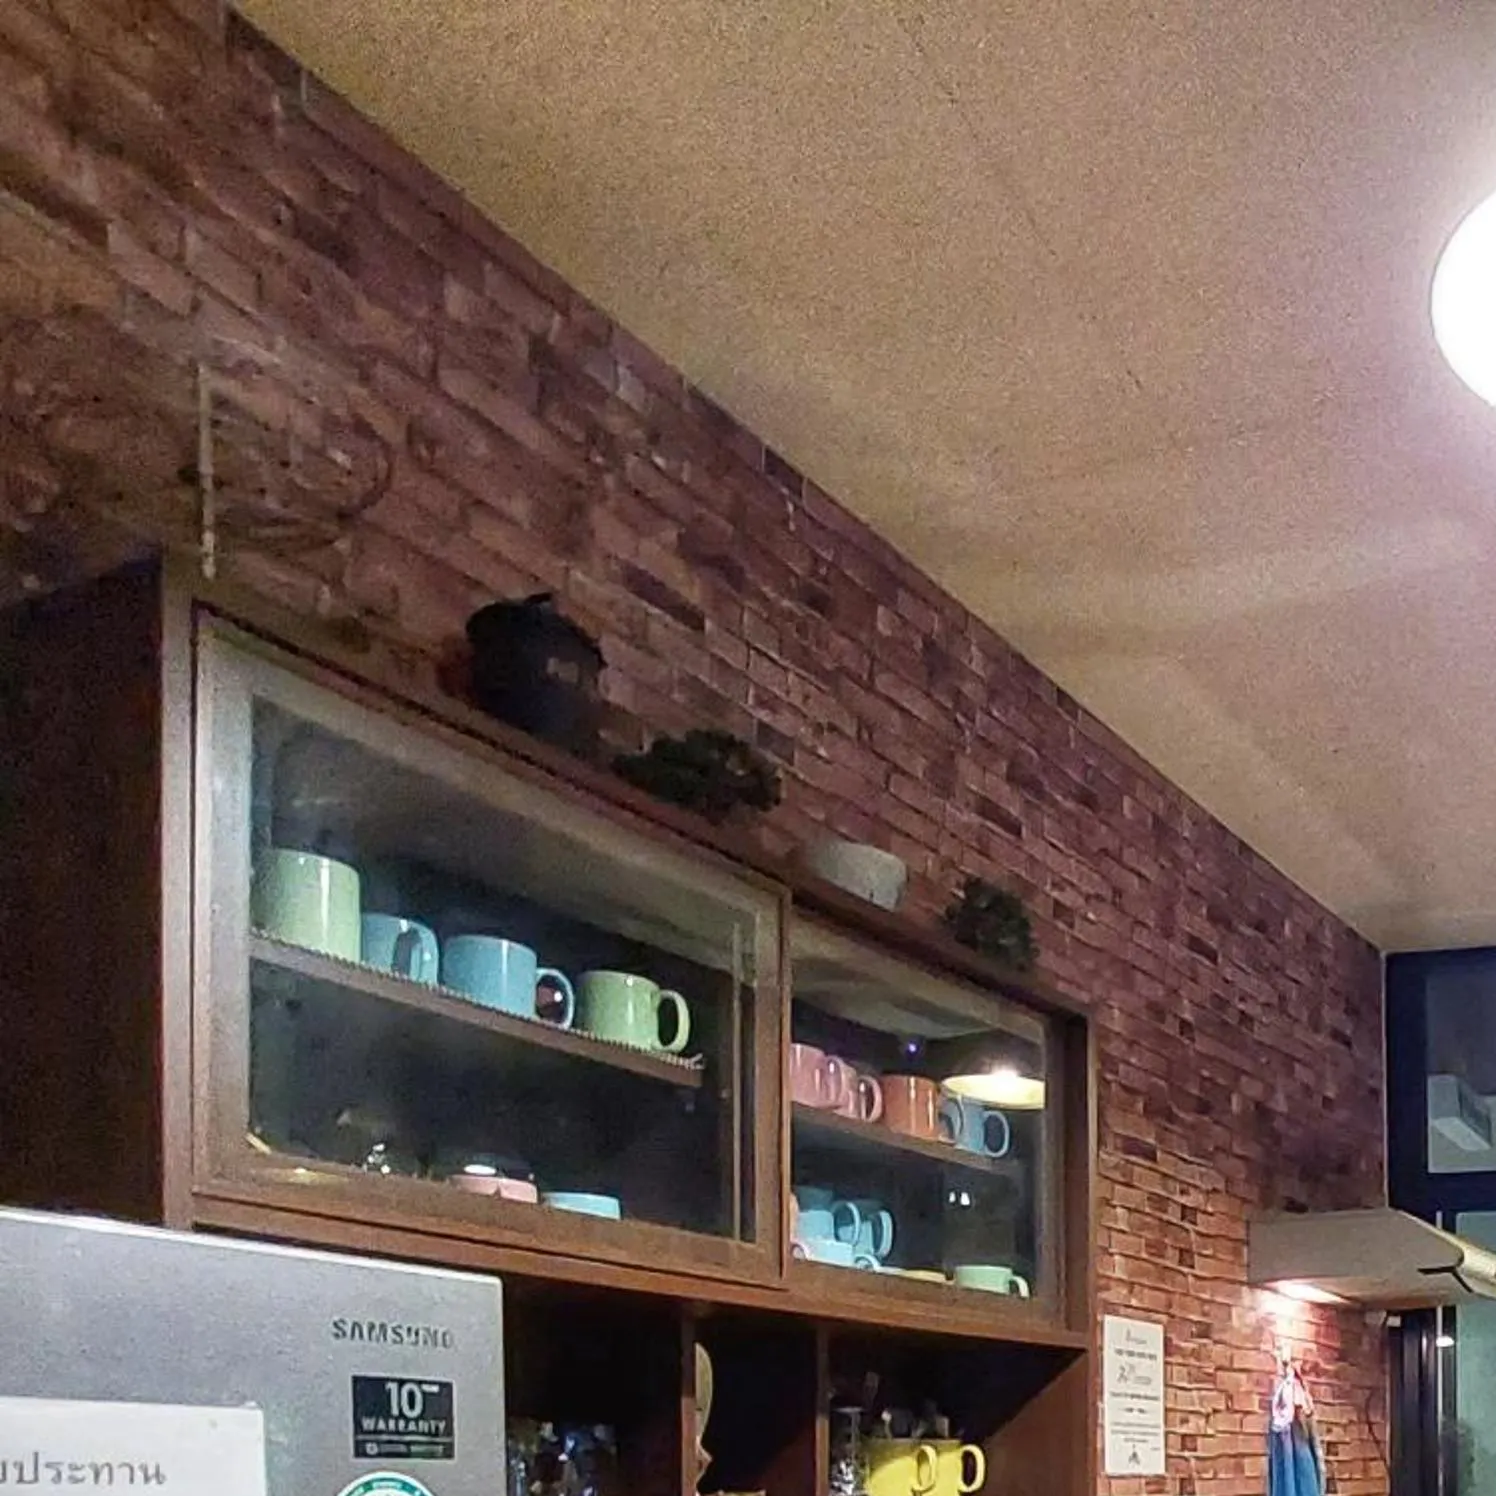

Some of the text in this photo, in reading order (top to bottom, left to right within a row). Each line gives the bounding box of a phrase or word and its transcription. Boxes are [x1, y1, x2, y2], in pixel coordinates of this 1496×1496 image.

[332, 1318, 453, 1349] SAMSUNG
[385, 1382, 423, 1418] 10
[361, 1416, 446, 1434] WARRANTY
